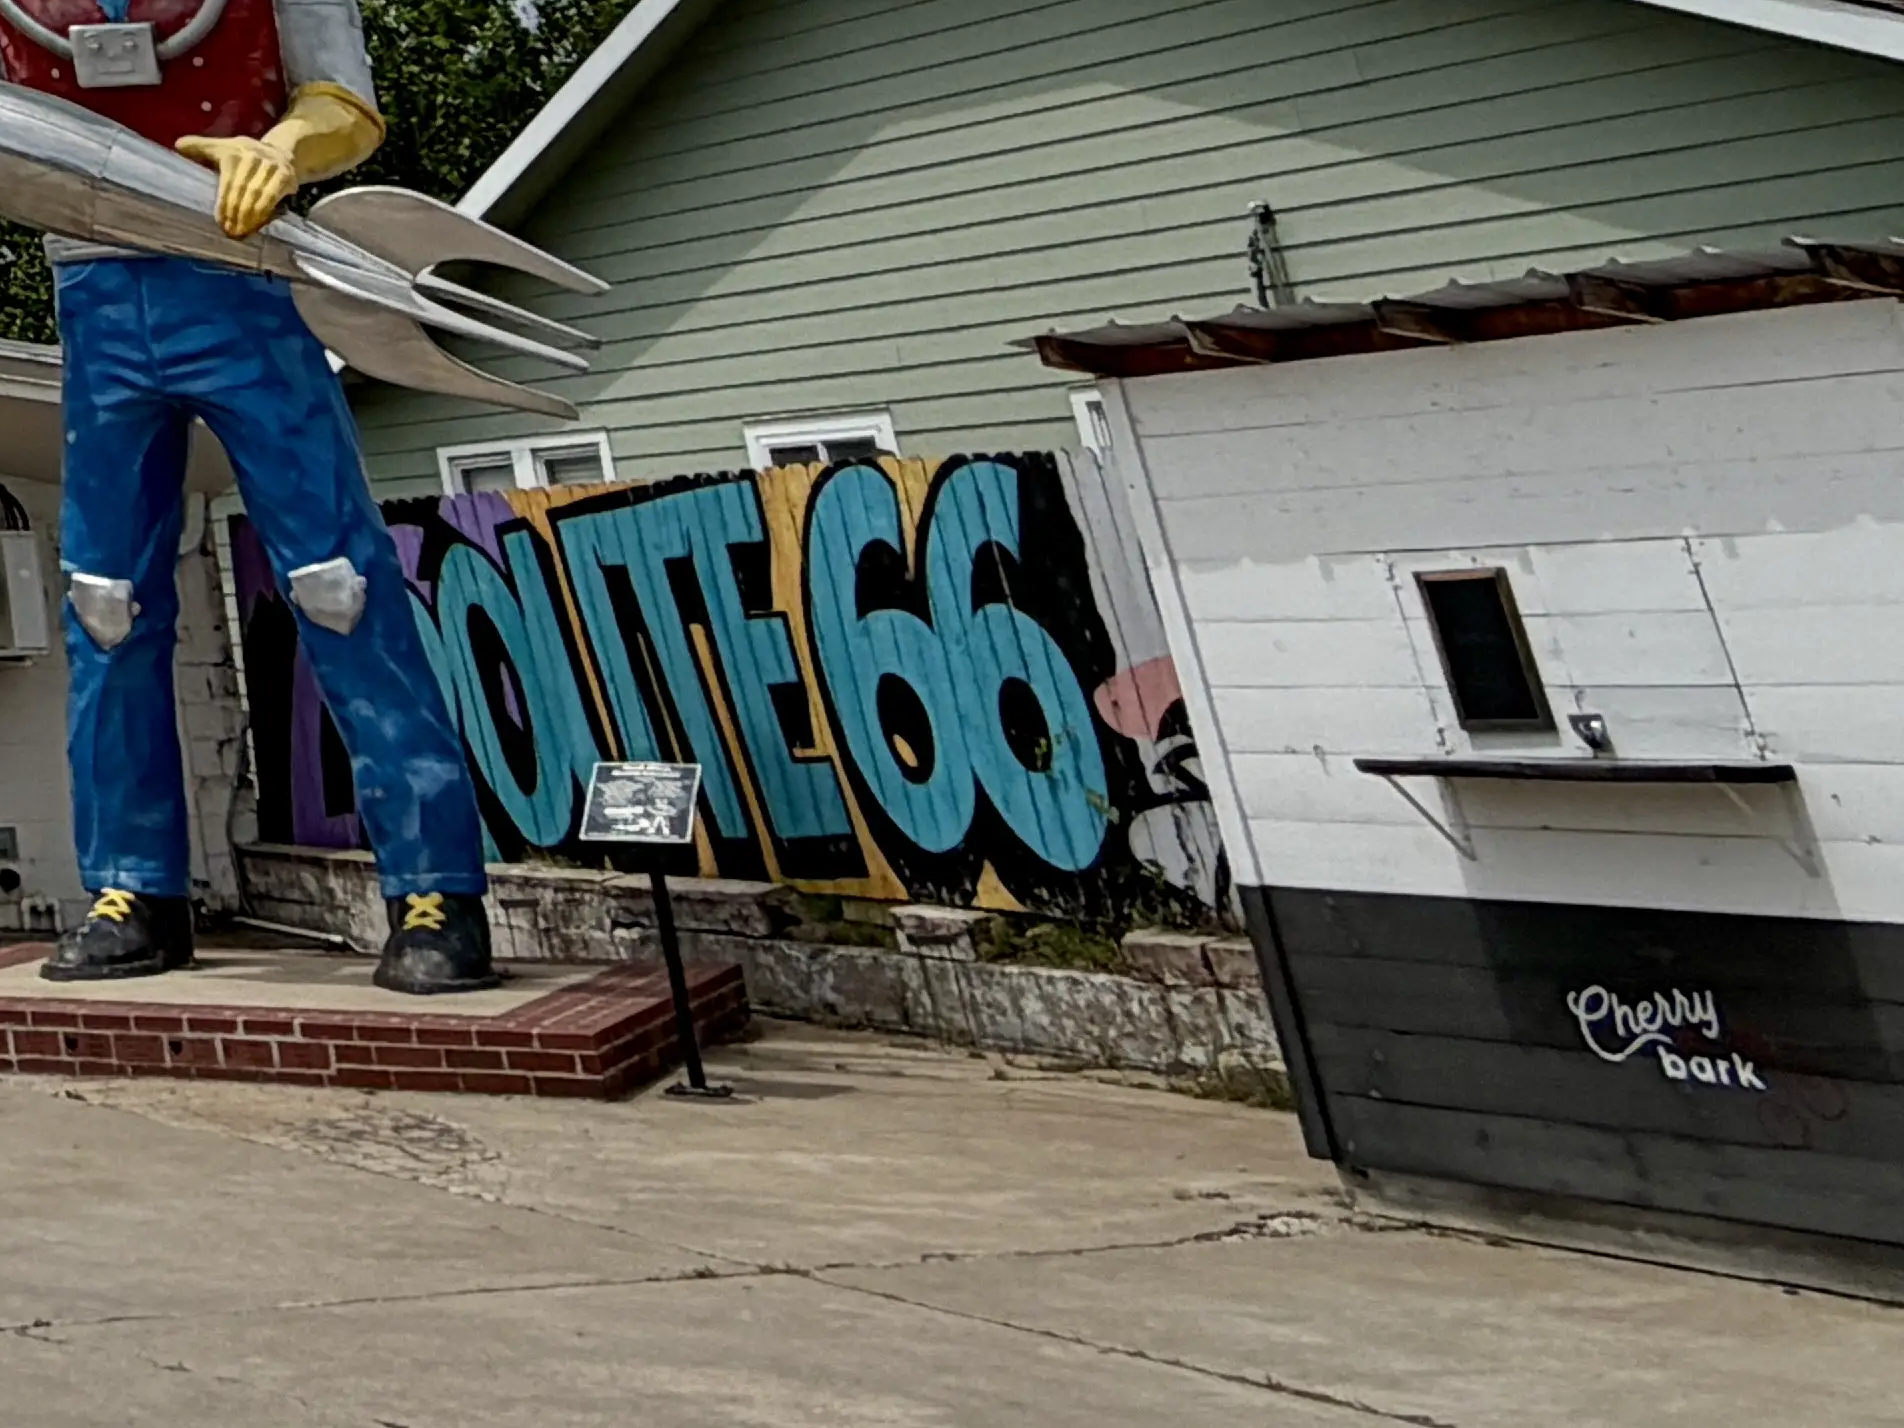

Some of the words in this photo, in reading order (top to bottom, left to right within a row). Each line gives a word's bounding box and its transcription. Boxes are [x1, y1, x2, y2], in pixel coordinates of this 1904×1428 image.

[809, 460, 1110, 871] 66
[1566, 984, 1720, 1062] Cherry
[1656, 1044, 1768, 1091] bark
